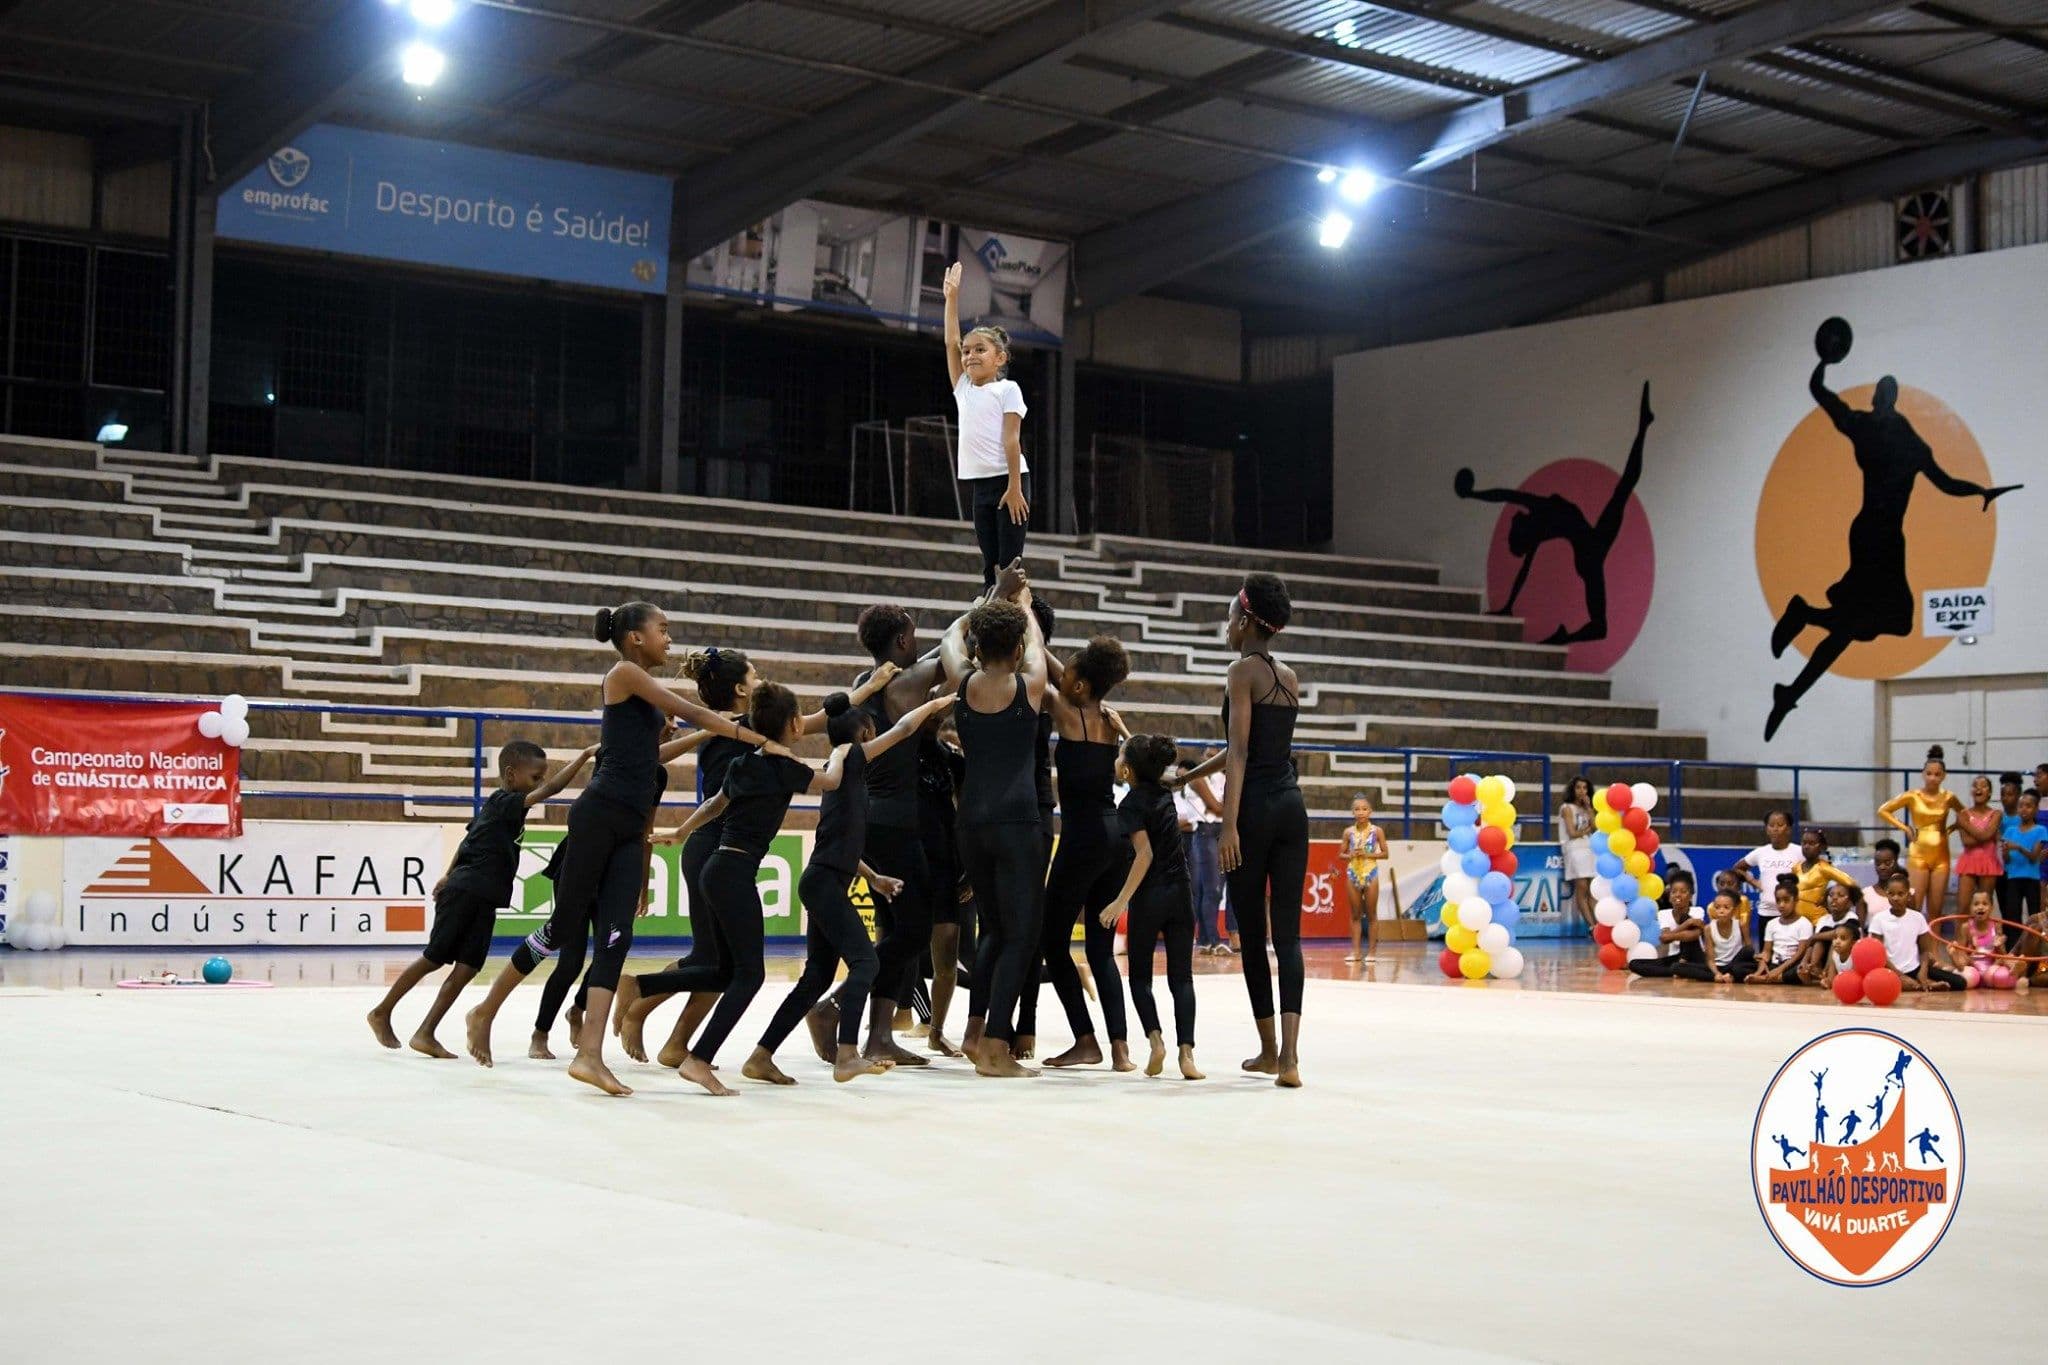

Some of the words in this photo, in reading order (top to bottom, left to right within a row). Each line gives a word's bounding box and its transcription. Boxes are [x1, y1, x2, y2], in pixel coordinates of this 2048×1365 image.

[243, 189, 329, 214] emprofac
[375, 181, 515, 229] Desporto
[526, 202, 544, 233] é
[553, 207, 650, 248] Saúde!
[1929, 594, 1986, 609] SAÍDA
[1936, 609, 1980, 623] EXIT
[31, 747, 144, 769] Campeonato
[150, 751, 223, 771] Nacional
[32, 771, 50, 786] de
[54, 769, 149, 789] GINÁSTICA
[153, 770, 227, 790] RÍTMICA
[219, 854, 425, 896] KAFAR
[1513, 877, 1574, 913] ZAP
[79, 905, 371, 933] Indústria
